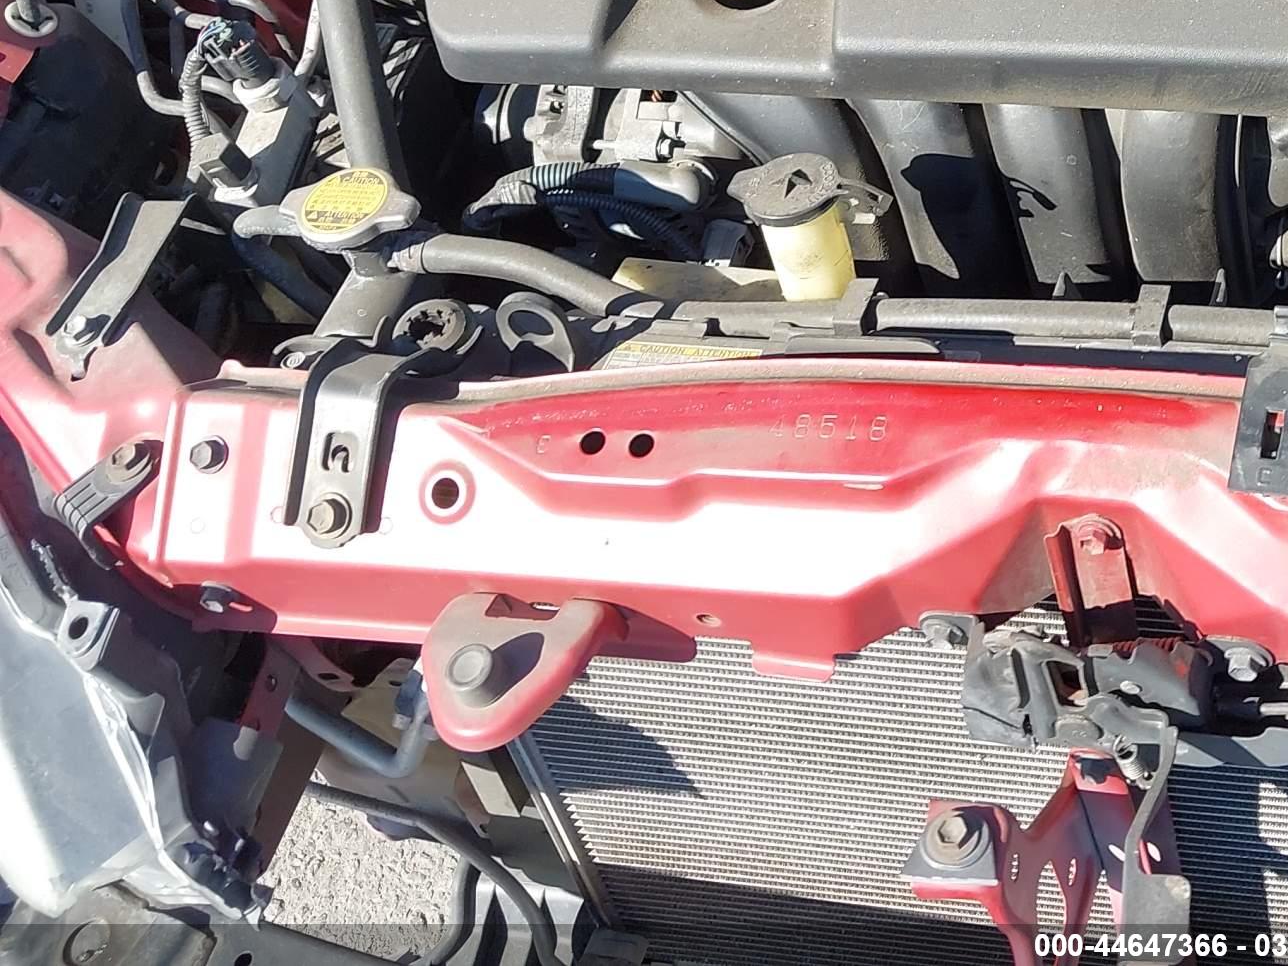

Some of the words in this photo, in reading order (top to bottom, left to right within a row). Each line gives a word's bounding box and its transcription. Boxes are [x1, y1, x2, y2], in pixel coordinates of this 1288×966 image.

[342, 175, 380, 185] CAUTION
[639, 344, 685, 355] CAUTION
[768, 414, 889, 441] 48518
